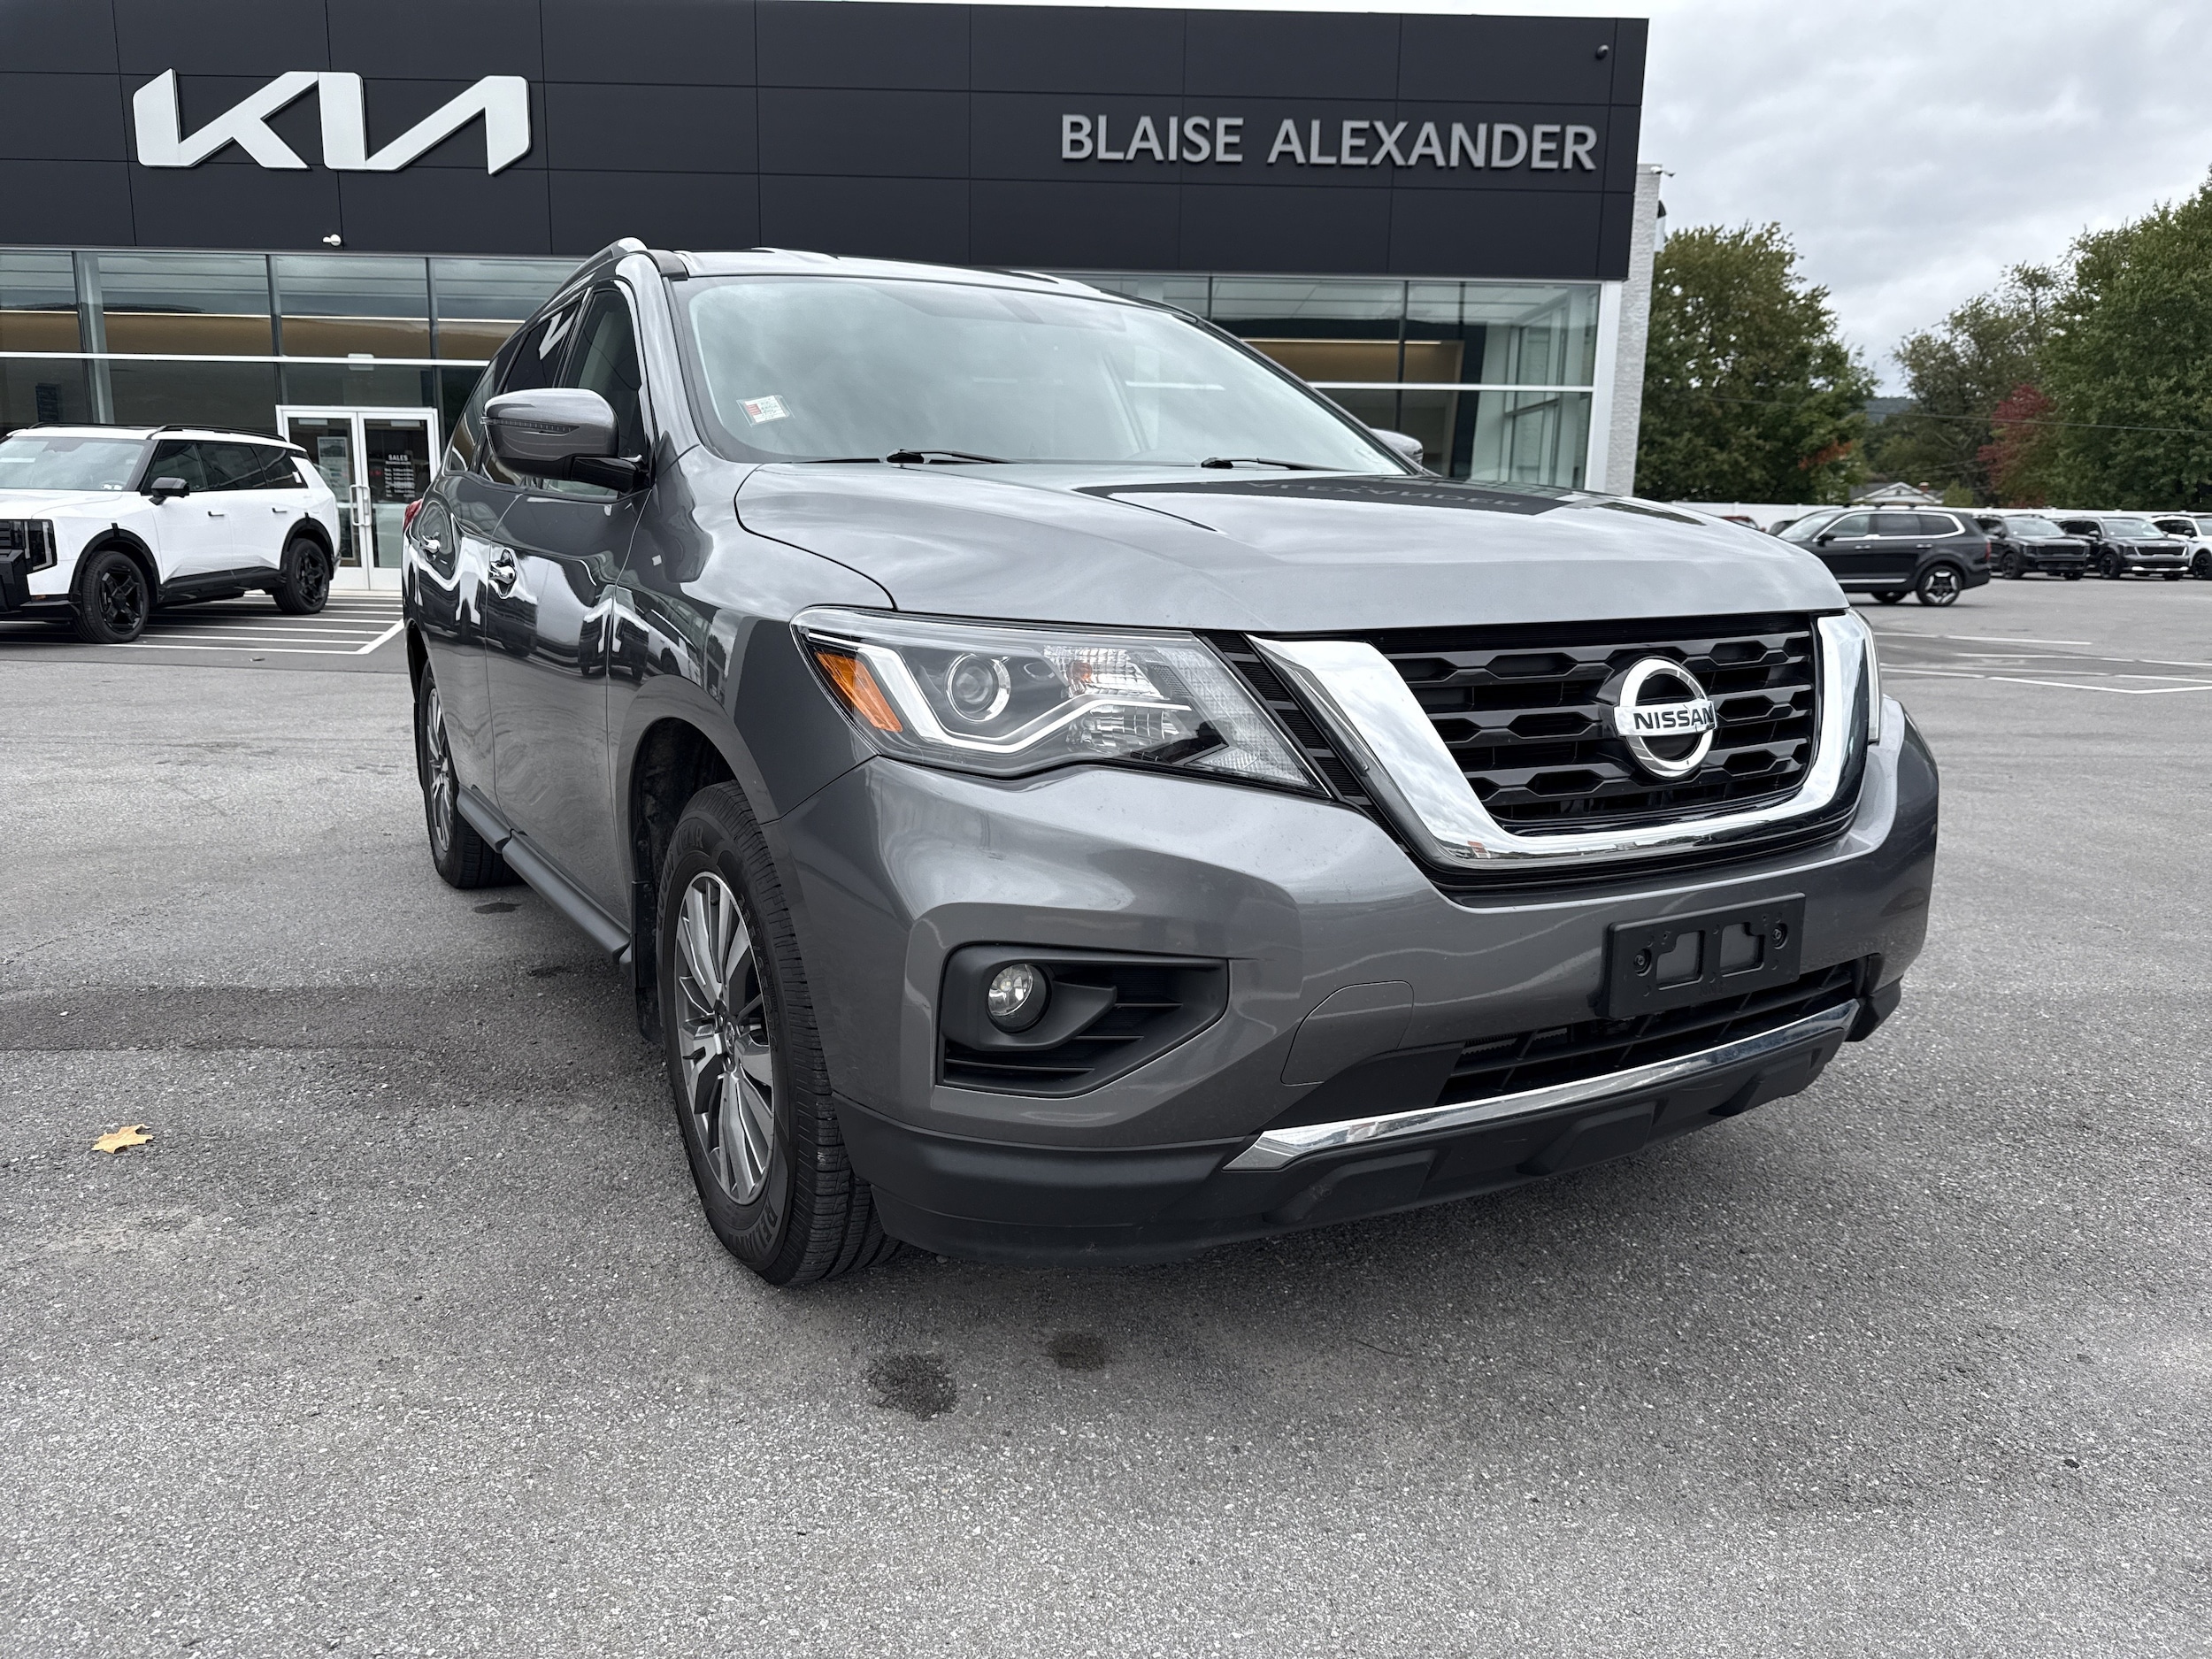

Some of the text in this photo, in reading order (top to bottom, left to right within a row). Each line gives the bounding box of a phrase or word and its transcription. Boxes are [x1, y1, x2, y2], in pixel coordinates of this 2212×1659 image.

[1062, 114, 1598, 171] BLAISE ALEXANDER
[1633, 708, 1716, 730] NISSAN
